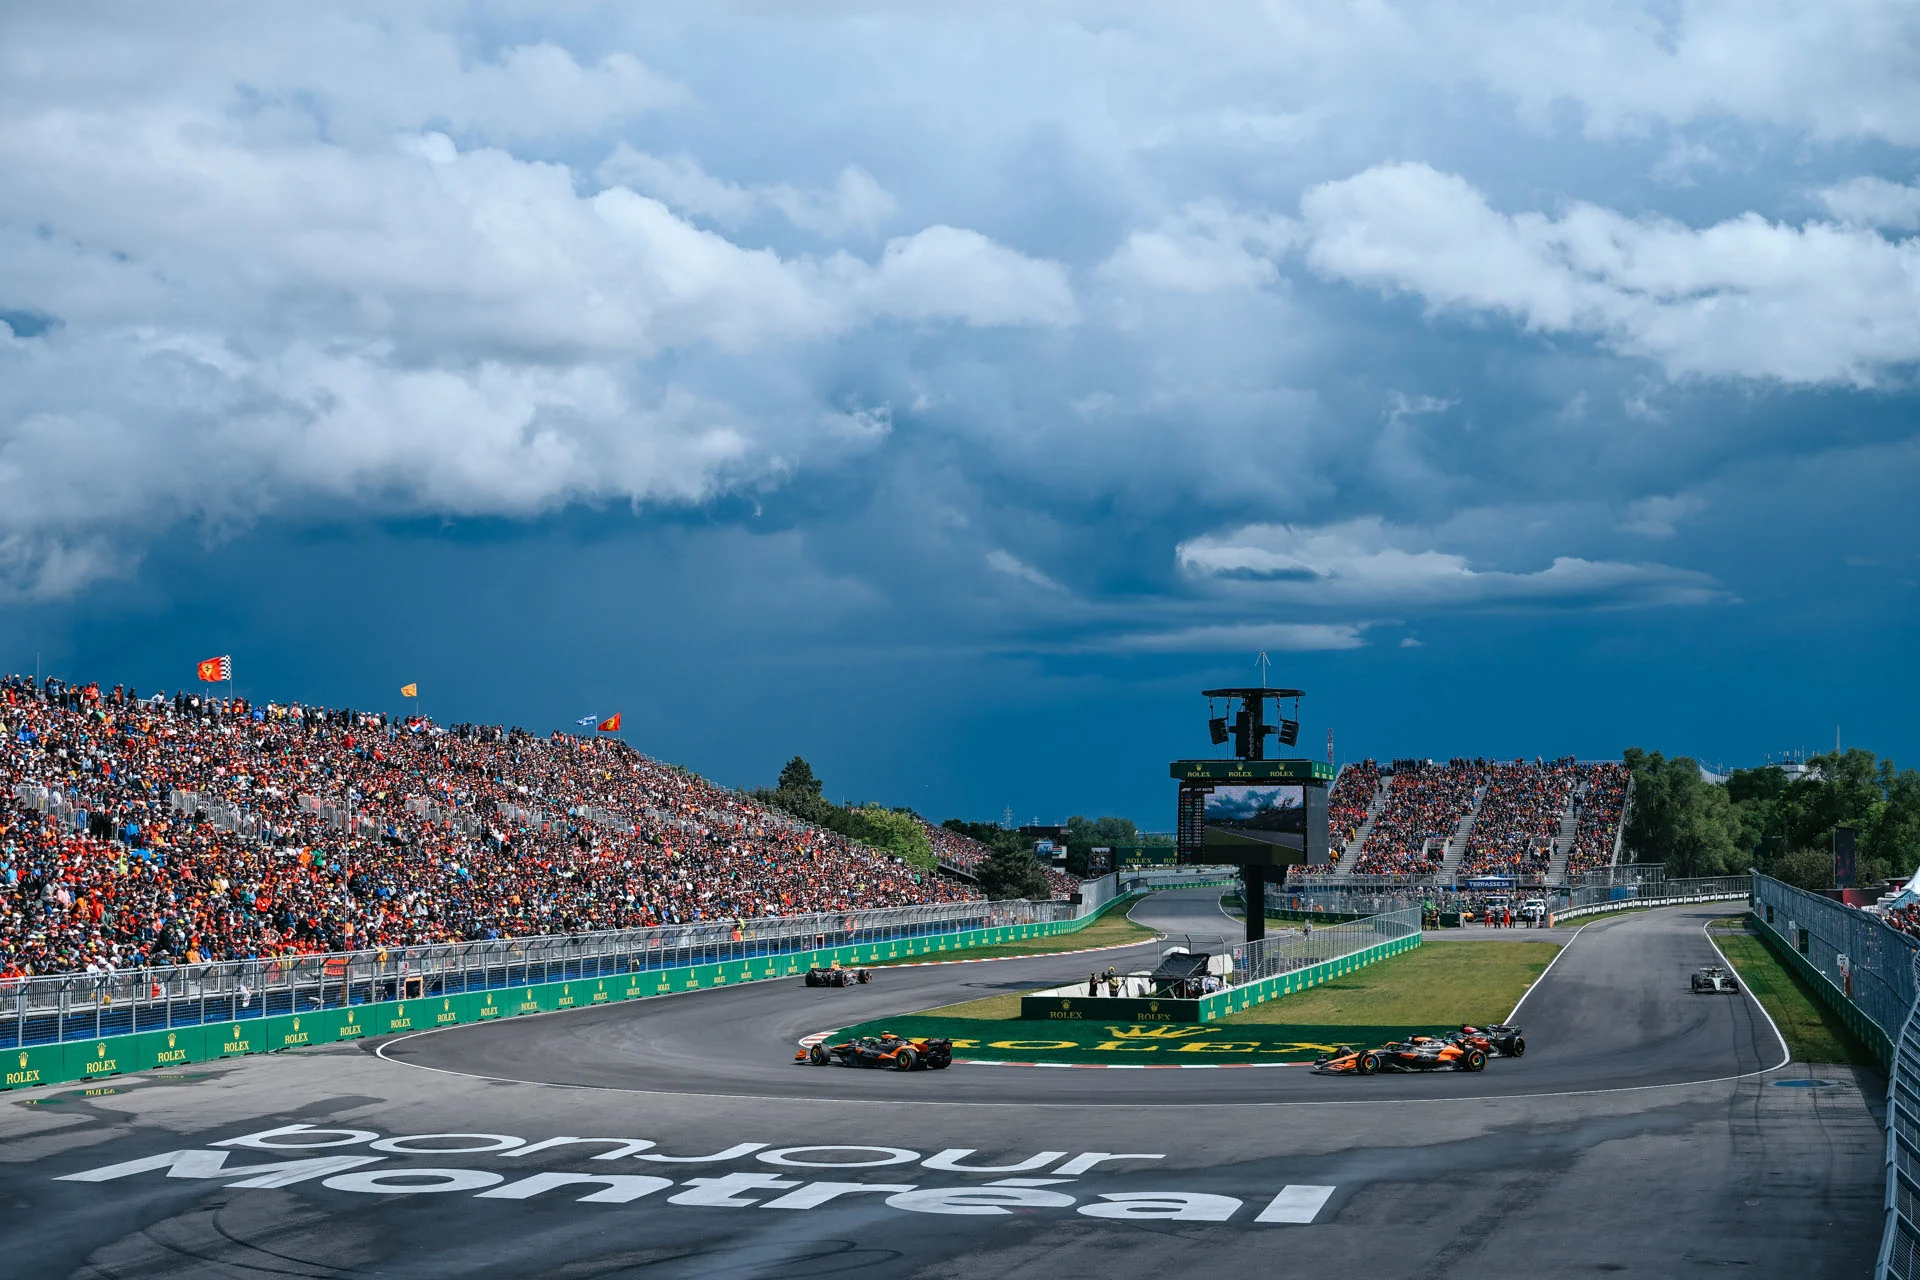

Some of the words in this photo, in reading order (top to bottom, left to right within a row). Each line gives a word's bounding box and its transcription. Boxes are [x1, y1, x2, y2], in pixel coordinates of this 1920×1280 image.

[559, 996, 574, 1006] ROLEX
[594, 992, 608, 1001] ROLEX
[480, 1006, 498, 1016] ROLEX
[521, 1001, 537, 1011] ROLEX
[391, 1017, 411, 1028] ROLEX
[437, 1012, 456, 1023] ROLEX
[1137, 1013, 1171, 1021] ROLEX
[340, 1025, 361, 1036] ROLEX
[284, 1032, 308, 1044] ROLEX
[224, 1040, 250, 1053] ROLEX
[158, 1049, 186, 1063] ROLEX
[86, 1059, 117, 1074] ROLEX
[6, 1069, 40, 1084] ROLEX
[53, 1149, 1336, 1224] Montréal
